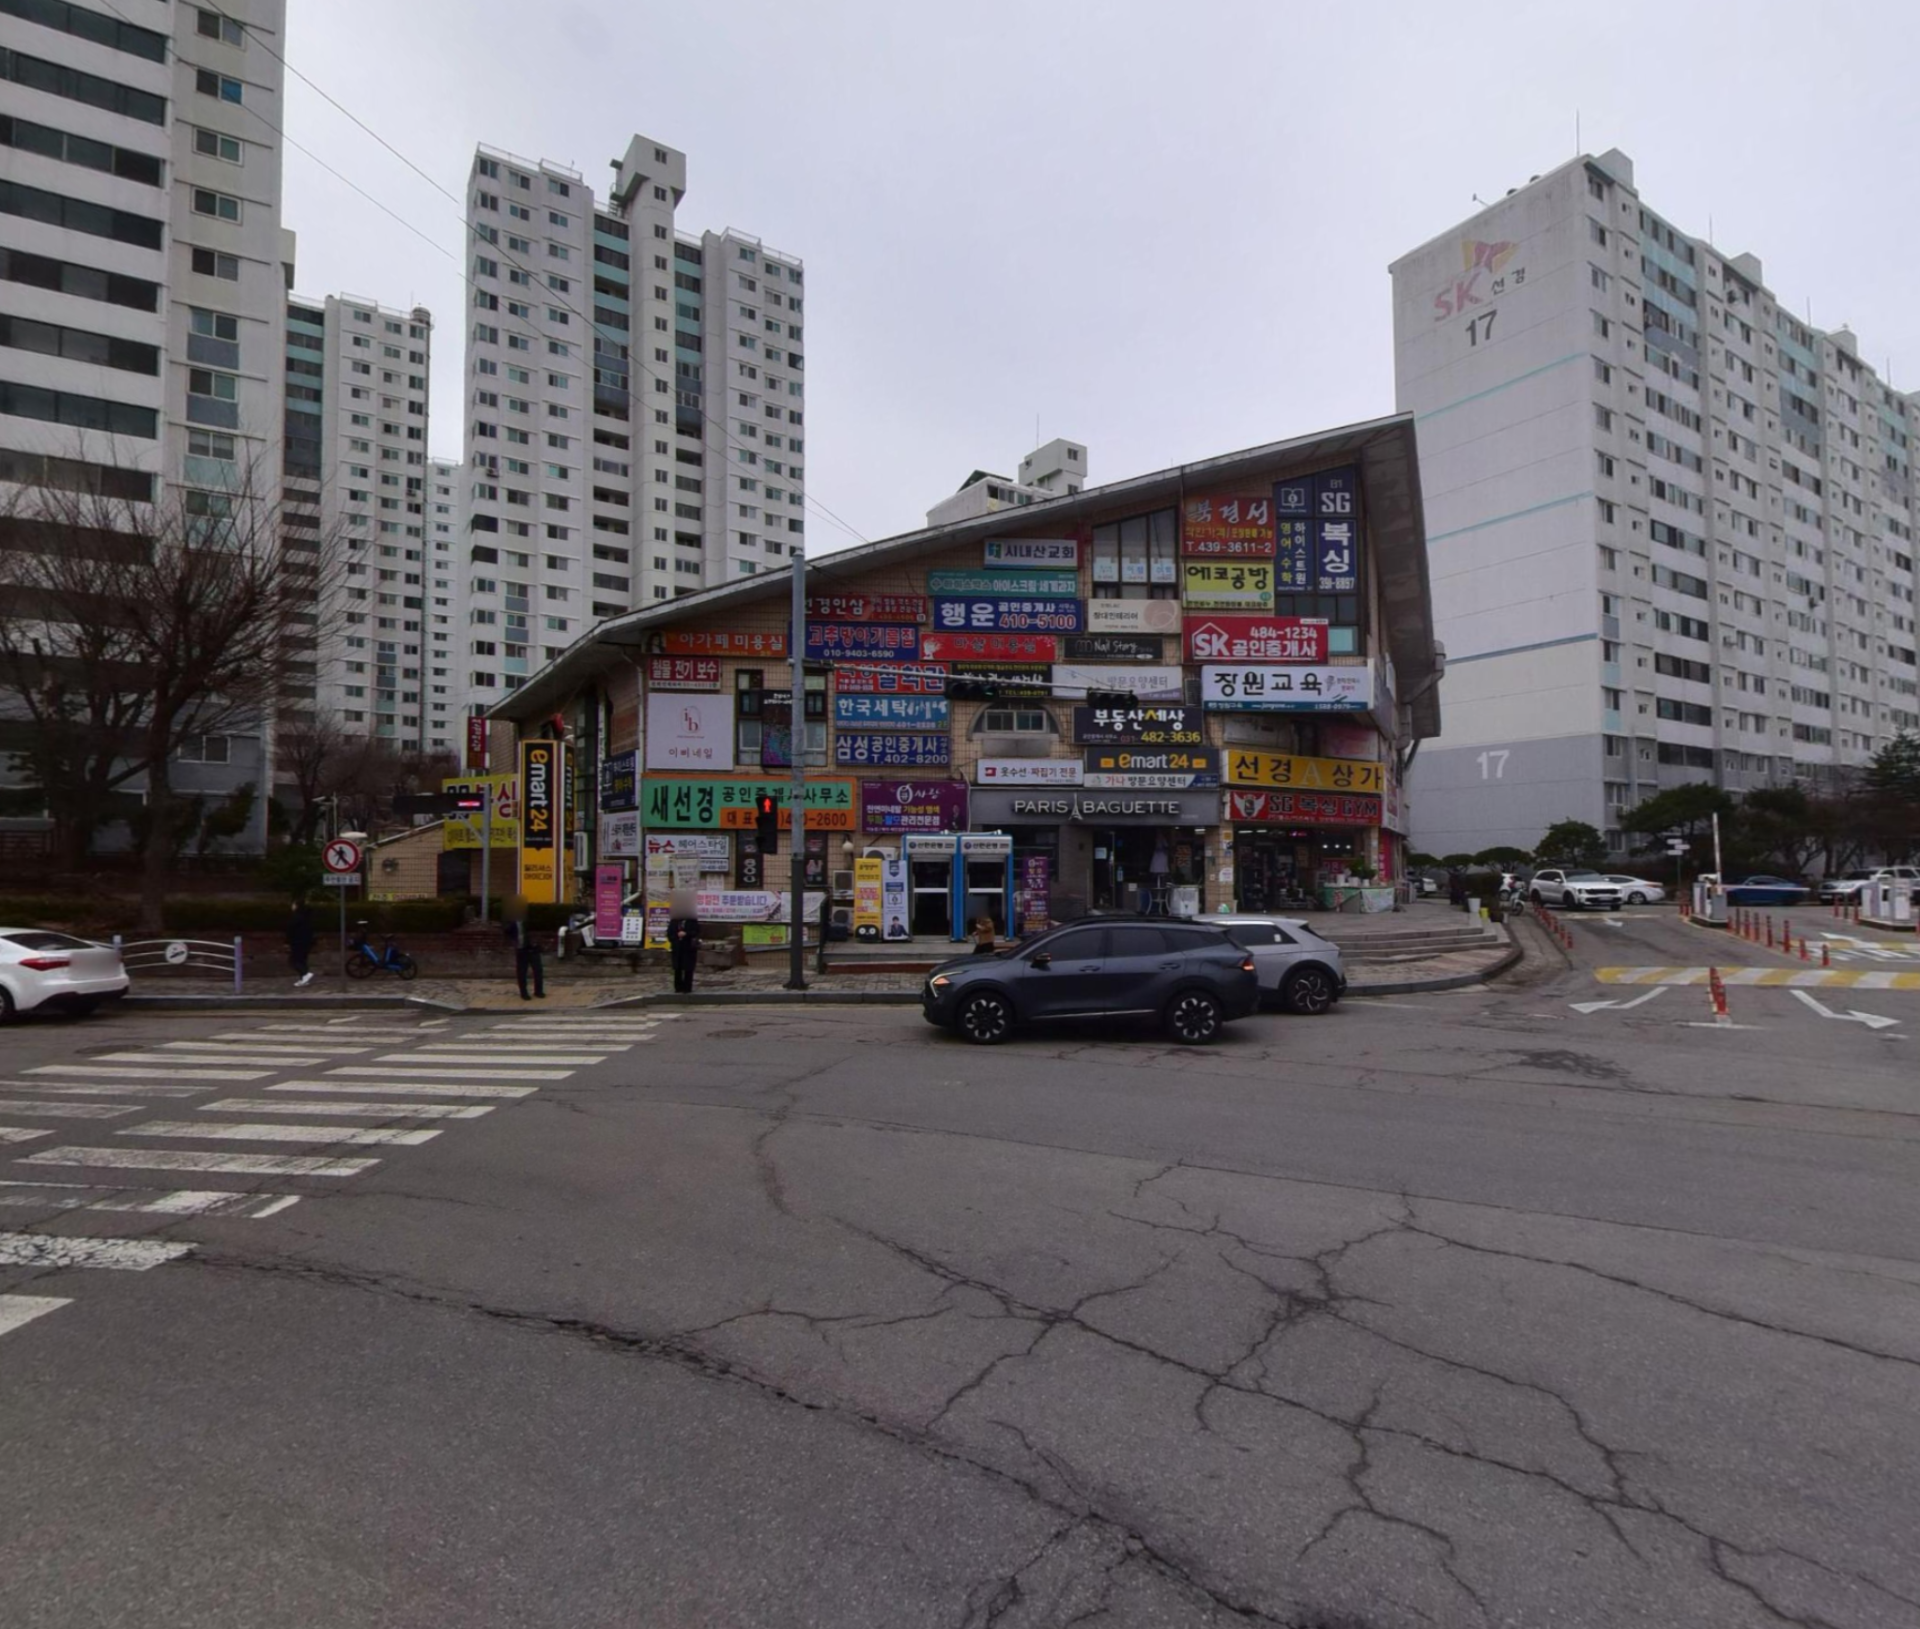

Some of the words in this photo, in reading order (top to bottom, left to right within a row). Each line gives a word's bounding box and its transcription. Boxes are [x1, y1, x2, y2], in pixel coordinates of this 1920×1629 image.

[1491, 267, 1525, 296] 선경
[1434, 271, 1484, 322] SK
[1465, 309, 1498, 347] 17
[1321, 493, 1351, 513] SG
[1004, 545, 1074, 558] 시내산교회
[1186, 541, 1272, 553] T.439-3611-2
[1294, 522, 1307, 585] 하이스트원
[1321, 522, 1352, 573] 복싱
[1187, 566, 1268, 591] 에코공방
[940, 603, 995, 626] 행운
[998, 602, 1055, 613] 공인중개사
[999, 614, 1076, 629] 410-5100
[679, 633, 729, 649] 아가페
[734, 634, 784, 652] 미용실
[808, 626, 916, 649] 고추방아기름집
[1250, 627, 1317, 639] 484-1234
[823, 649, 895, 658] 010-9403-6590
[1094, 638, 1111, 654] Nail
[1113, 640, 1138, 653] Story
[1195, 634, 1230, 657] SK
[1232, 640, 1317, 657] 공인중개사
[652, 659, 671, 679] 철물
[675, 660, 694, 680] 전기
[696, 660, 718, 680] 보수
[1214, 671, 1322, 697] 장원교육
[838, 699, 907, 717] 한국세탁
[1093, 709, 1185, 732] 부동산세상
[1141, 731, 1202, 743] 482-3636
[836, 737, 869, 760] 삼성
[872, 737, 937, 754] 공인중개사
[871, 754, 949, 764] T.402-8200
[1118, 753, 1169, 770] emart
[1169, 754, 1189, 769] 24
[1476, 750, 1510, 780] 17
[1059, 767, 1077, 778] 전문
[1105, 777, 1125, 787] 가나
[1128, 776, 1186, 788] 방문요양센터
[1236, 756, 1291, 784] 선경
[1300, 762, 1322, 786] A
[1332, 764, 1381, 790] 상가
[650, 786, 714, 823] 새선경
[1014, 800, 1068, 813] PARIS
[1083, 801, 1178, 814] BAGUETTE
[1269, 795, 1294, 814] SG
[1343, 799, 1379, 817] GYM
[649, 840, 675, 853] 뉴스
[678, 840, 727, 851] 헤어스타일
[722, 895, 767, 906] 주문받습니다
